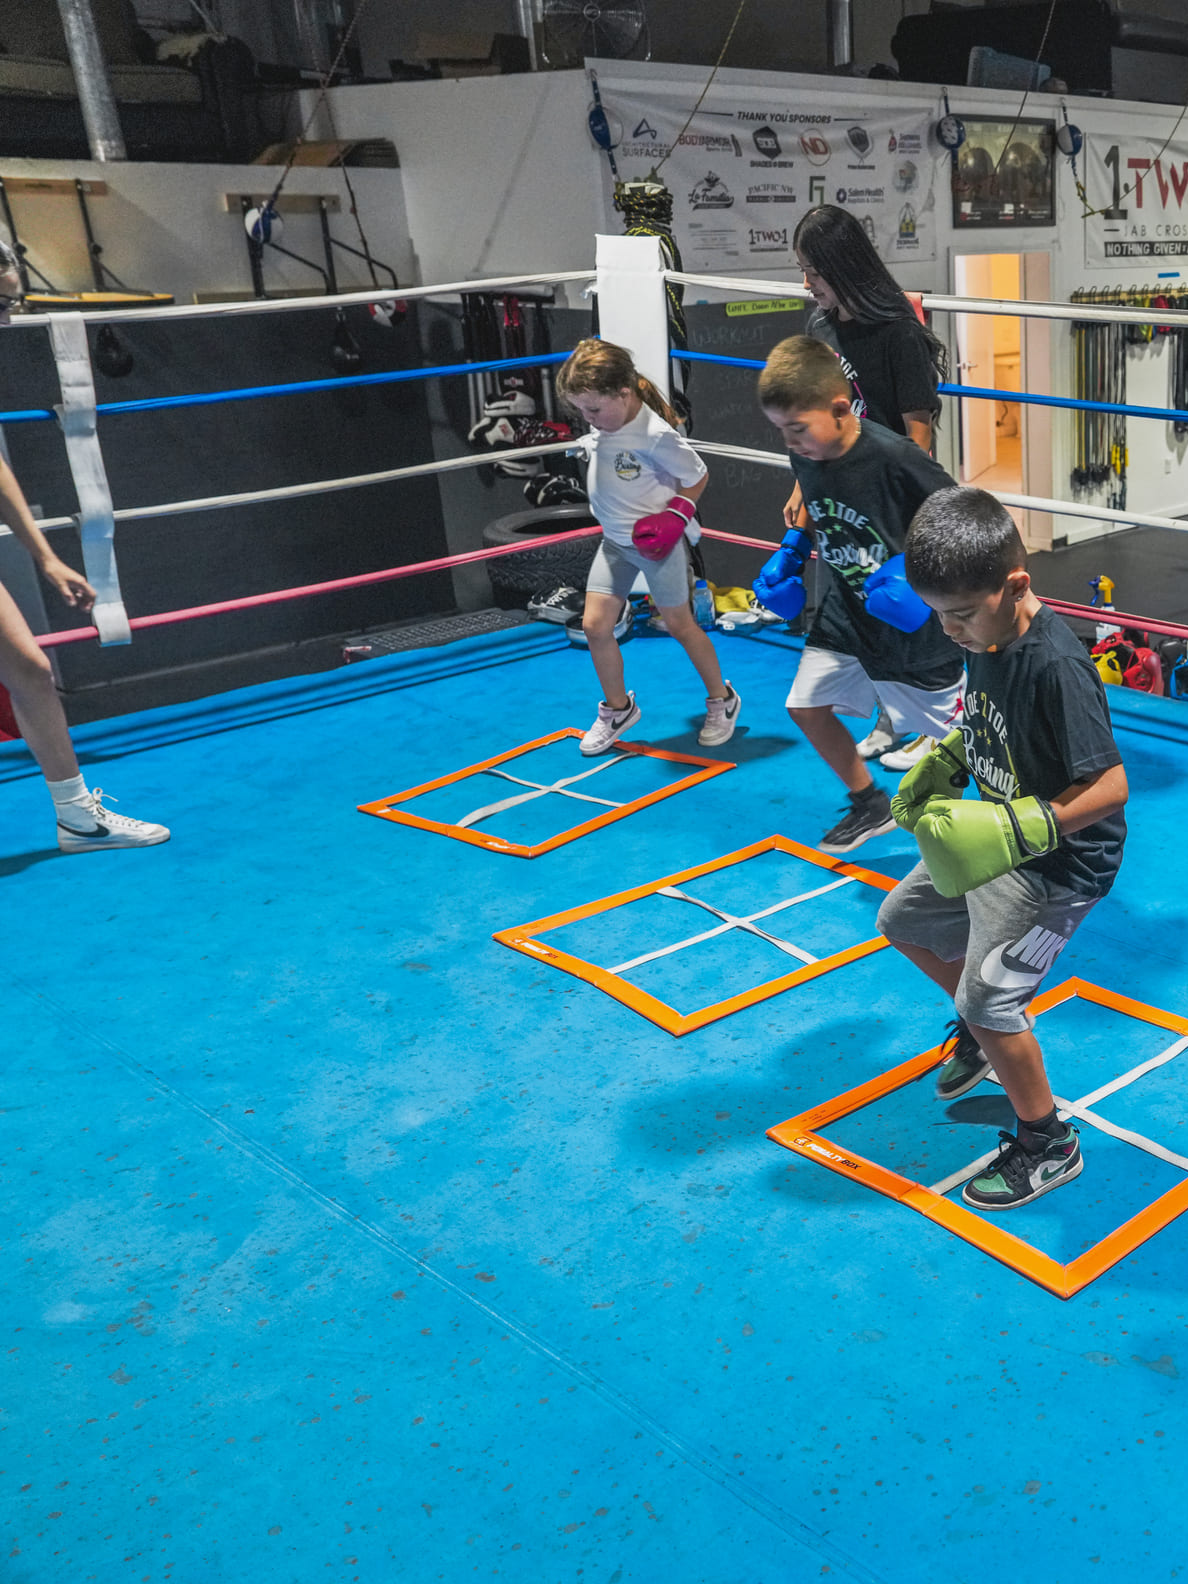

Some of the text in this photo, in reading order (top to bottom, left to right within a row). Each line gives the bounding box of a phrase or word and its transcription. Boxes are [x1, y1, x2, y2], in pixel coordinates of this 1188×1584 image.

[738, 111, 832, 124] THANK YOU SPONSORS
[1124, 224, 1147, 237] JAB
[1107, 242, 1150, 256] NOTHING
[1153, 241, 1181, 255] GIVEN
[823, 498, 837, 517] 2
[836, 501, 870, 530] TOE
[980, 692, 987, 718] 2
[988, 700, 1008, 745] TOE
[1006, 925, 1069, 970] NIK
